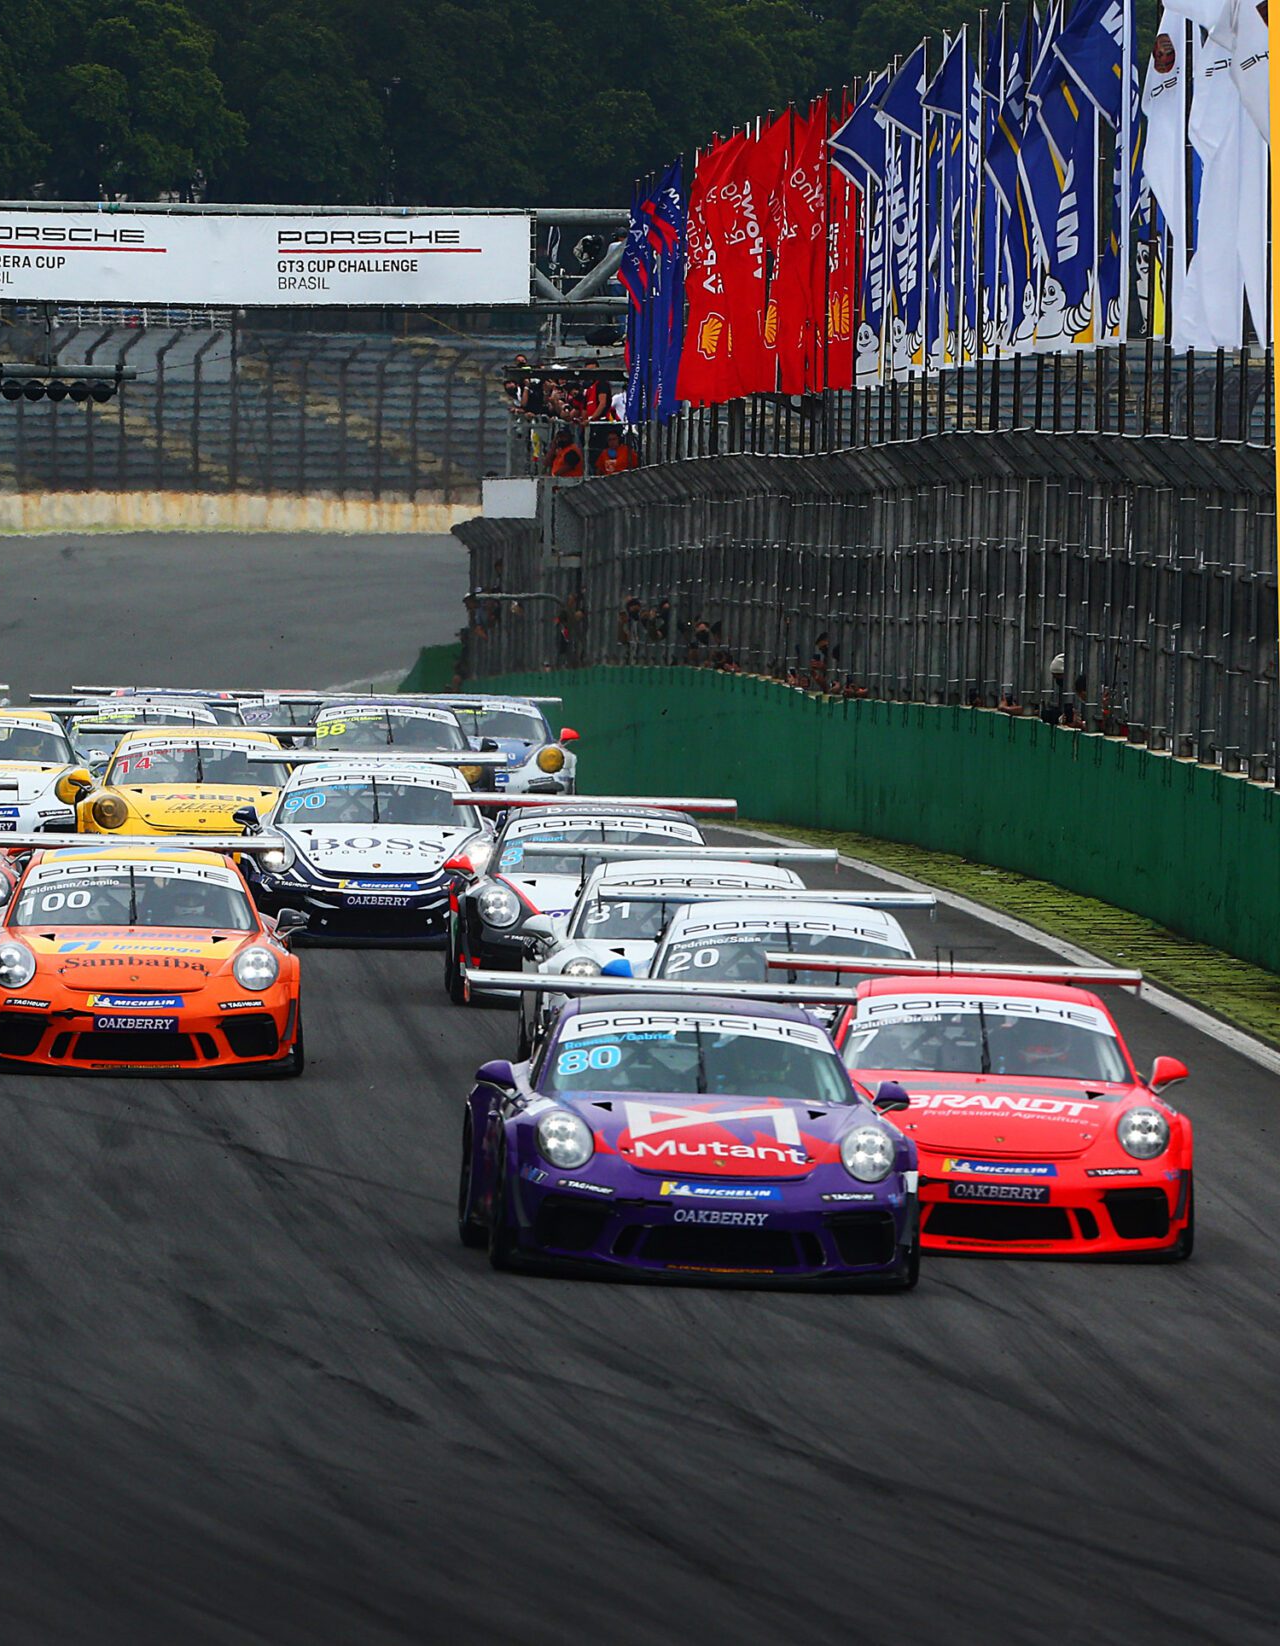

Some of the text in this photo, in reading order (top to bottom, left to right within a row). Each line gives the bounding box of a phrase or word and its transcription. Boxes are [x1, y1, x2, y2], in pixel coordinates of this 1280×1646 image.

[278, 231, 459, 245] PORSCHE
[36, 255, 65, 269] CUP
[278, 260, 418, 273] GT3 CUP CHALLENGE
[278, 277, 329, 290] BRASIL
[116, 757, 153, 774] 14
[298, 775, 457, 791] PORSCHE
[284, 792, 326, 814] 90
[518, 820, 693, 837] PORSCHE
[309, 836, 446, 853] BOSS
[39, 865, 230, 883] PORSCHE
[18, 890, 92, 916] 100
[347, 896, 410, 906] OAKBERRY
[587, 902, 631, 925] 31
[683, 920, 889, 942] PORSCHE
[666, 948, 719, 974] 20
[114, 999, 176, 1007] MICHELIN
[869, 1000, 1098, 1026] PORSCHE
[98, 1018, 175, 1030] OAKBERRY
[578, 1016, 819, 1044] PORSCHE
[851, 1028, 880, 1053] 7
[558, 1045, 621, 1075] 80
[923, 1108, 1089, 1126] Professional Agriculture
[634, 1139, 805, 1165] Mutant
[975, 1165, 1048, 1175] MICHELIN
[695, 1188, 771, 1197] MICHELIN
[954, 1184, 1045, 1200] OAKBERRY
[673, 1209, 769, 1227] OAKBERRY
